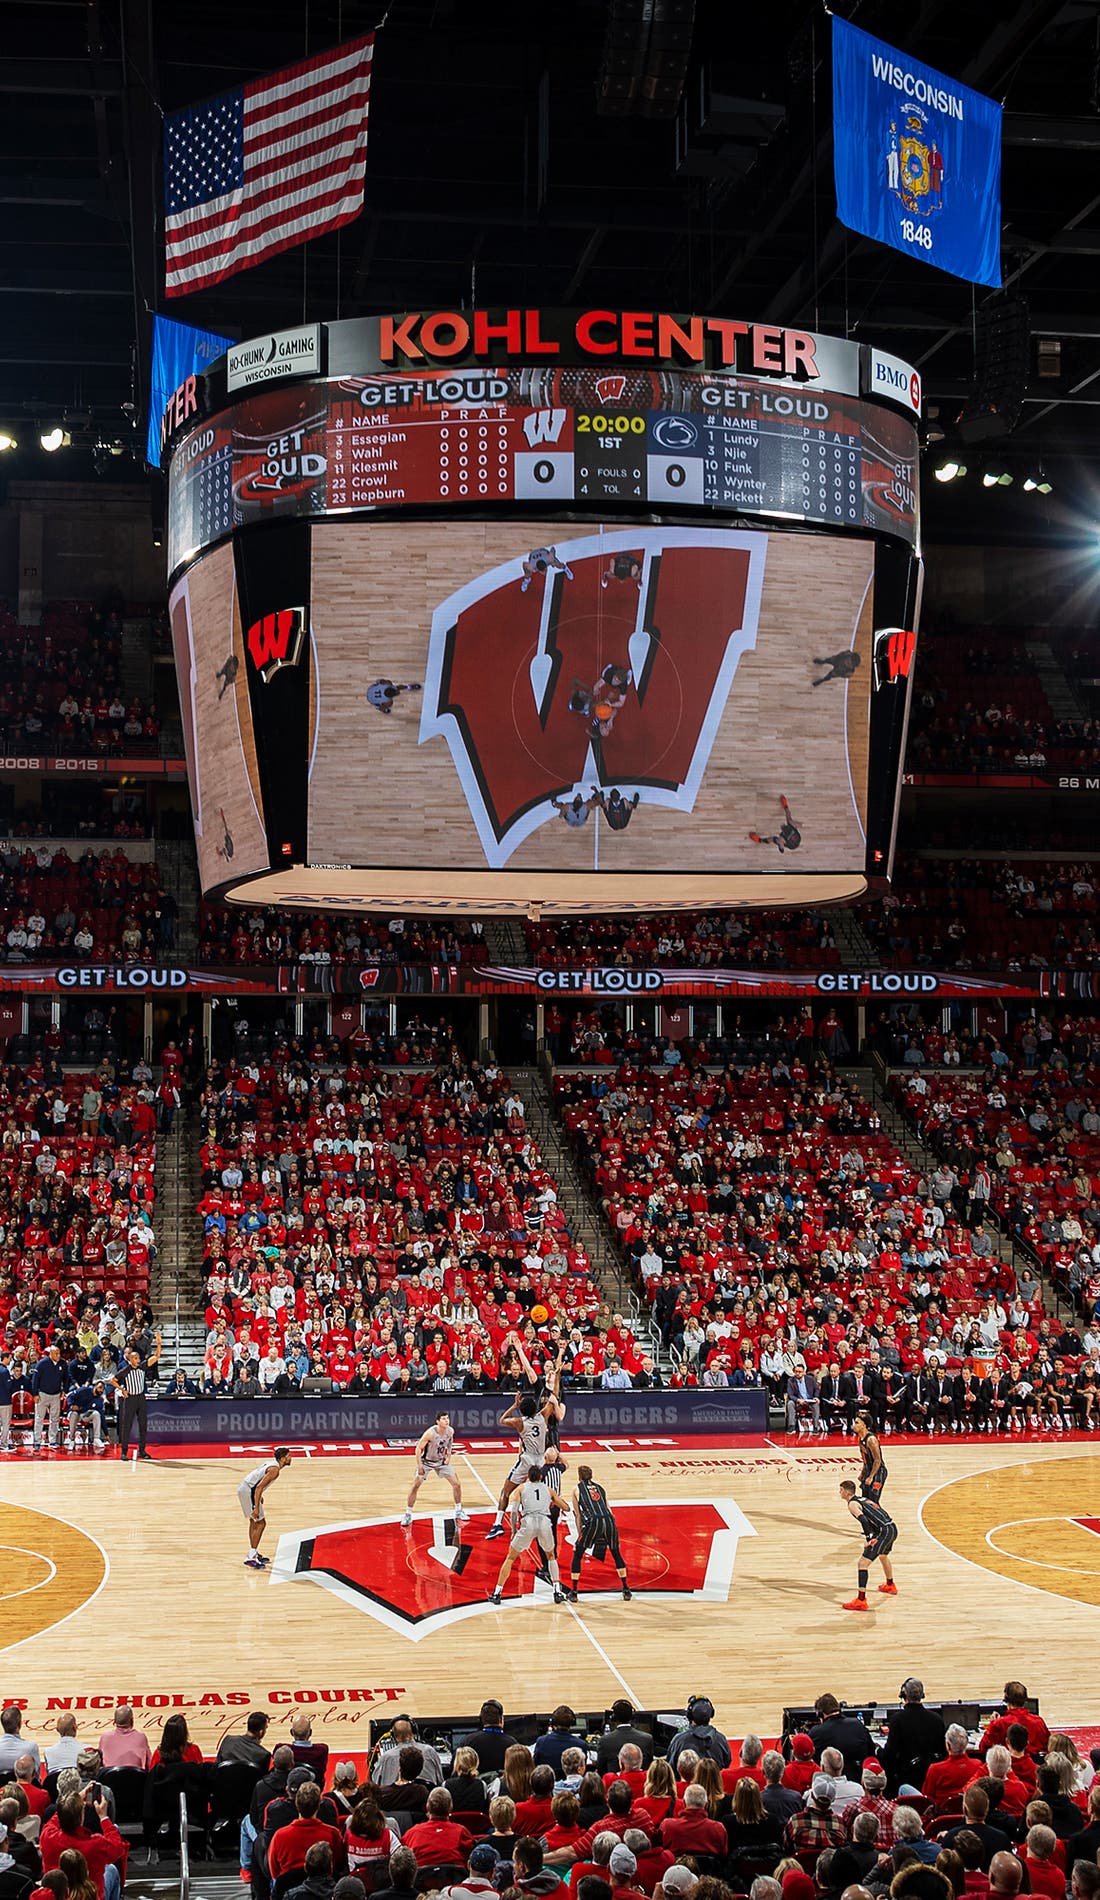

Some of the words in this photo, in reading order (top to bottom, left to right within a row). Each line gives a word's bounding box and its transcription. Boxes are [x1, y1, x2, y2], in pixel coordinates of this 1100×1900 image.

[872, 54, 962, 120] WISCONSIN
[900, 218, 932, 250] 1848
[380, 310, 560, 360] KOHL
[575, 311, 820, 377] CENTER
[230, 348, 264, 372] HO-CHUNK
[278, 338, 314, 356] GAMING
[245, 364, 292, 382] WISCONSIN
[876, 362, 908, 391] BMO
[360, 384, 414, 406] GET
[426, 381, 509, 401] LOUD
[702, 388, 750, 408] GET
[762, 394, 829, 420] LOUD
[352, 414, 390, 428] NAME
[441, 410, 449, 420] P
[460, 410, 468, 420] R
[479, 409, 488, 419] A
[499, 408, 507, 418] F
[577, 415, 646, 434] 20:00
[336, 436, 344, 446] 3
[440, 428, 449, 438] 0
[460, 427, 468, 438] 0
[478, 426, 488, 437] 0
[498, 425, 508, 436] 0
[723, 417, 758, 430] NAME
[804, 428, 810, 436] P
[819, 431, 826, 440] R
[834, 434, 841, 442] A
[849, 437, 854, 446] F
[188, 430, 214, 461] LOUD
[267, 430, 305, 458] GET
[352, 447, 383, 460] Wahl
[440, 442, 449, 452] 0
[460, 441, 468, 452] 0
[478, 440, 488, 451] 0
[498, 440, 508, 450] 0
[598, 438, 622, 448] 1ST
[708, 431, 714, 441] 1
[724, 433, 758, 448] Lundy
[803, 444, 810, 453] 0
[819, 447, 826, 456] 0
[834, 450, 841, 459] 0
[849, 452, 855, 462] 0
[262, 454, 326, 477] LOUD
[335, 464, 344, 474] 11
[440, 456, 449, 467] 0
[460, 456, 468, 466] 0
[478, 454, 488, 466] 0
[498, 454, 508, 464] 0
[708, 446, 714, 456] 3
[803, 458, 810, 467] 0
[819, 460, 826, 470] 0
[834, 464, 841, 473] 0
[849, 466, 855, 476] 0
[332, 479, 346, 489] 22
[352, 475, 388, 488] Crowl
[440, 470, 449, 481] 0
[460, 470, 468, 480] 0
[478, 468, 488, 480] 0
[498, 468, 508, 478] 0
[534, 460, 554, 484] 0
[580, 468, 588, 478] 0
[597, 468, 628, 478] FOULS
[633, 469, 640, 479] 0
[666, 464, 686, 488] 0
[705, 460, 718, 470] 10
[725, 462, 752, 474] Funk
[803, 472, 810, 481] 0
[819, 475, 826, 484] 0
[834, 478, 841, 487] 0
[849, 480, 855, 490] 0
[894, 464, 911, 482] GET
[332, 493, 346, 504] 23
[352, 488, 406, 502] Hepburn
[440, 484, 449, 496] 0
[460, 484, 468, 495] 0
[478, 483, 488, 494] 0
[498, 482, 508, 492] 0
[581, 485, 588, 494] 4
[604, 485, 620, 494] TOL
[634, 486, 640, 496] 4
[706, 475, 716, 484] 11
[725, 476, 766, 490] Wynter
[804, 486, 810, 496] 0
[820, 489, 826, 498] 0
[835, 492, 841, 501] 0
[850, 494, 856, 504] 0
[892, 480, 916, 513] LOUD
[705, 490, 719, 500] 22
[724, 490, 763, 504] Pickett
[804, 501, 810, 510] 0
[820, 503, 826, 512] 0
[835, 506, 841, 515] 0
[850, 508, 856, 518] 0
[55, 760, 98, 770] 2015
[1059, 778, 1080, 788] 26
[58, 968, 106, 987] GET
[116, 968, 188, 987] LOUD
[538, 970, 584, 990] GET
[593, 970, 662, 990] LOUD
[818, 974, 862, 992] GET
[872, 974, 937, 992] LOUD
[217, 1412, 284, 1431] PROUD
[291, 1412, 380, 1430] PARTNER
[390, 1415, 404, 1426] OF
[408, 1414, 428, 1425] THE
[574, 1407, 678, 1426] BADGERS
[532, 1426, 540, 1438] 3
[660, 1458, 788, 1468] NICHOLAS
[534, 1488, 540, 1500] 1
[46, 1692, 250, 1710] NICHOLAS
[268, 1688, 406, 1704] COURT
